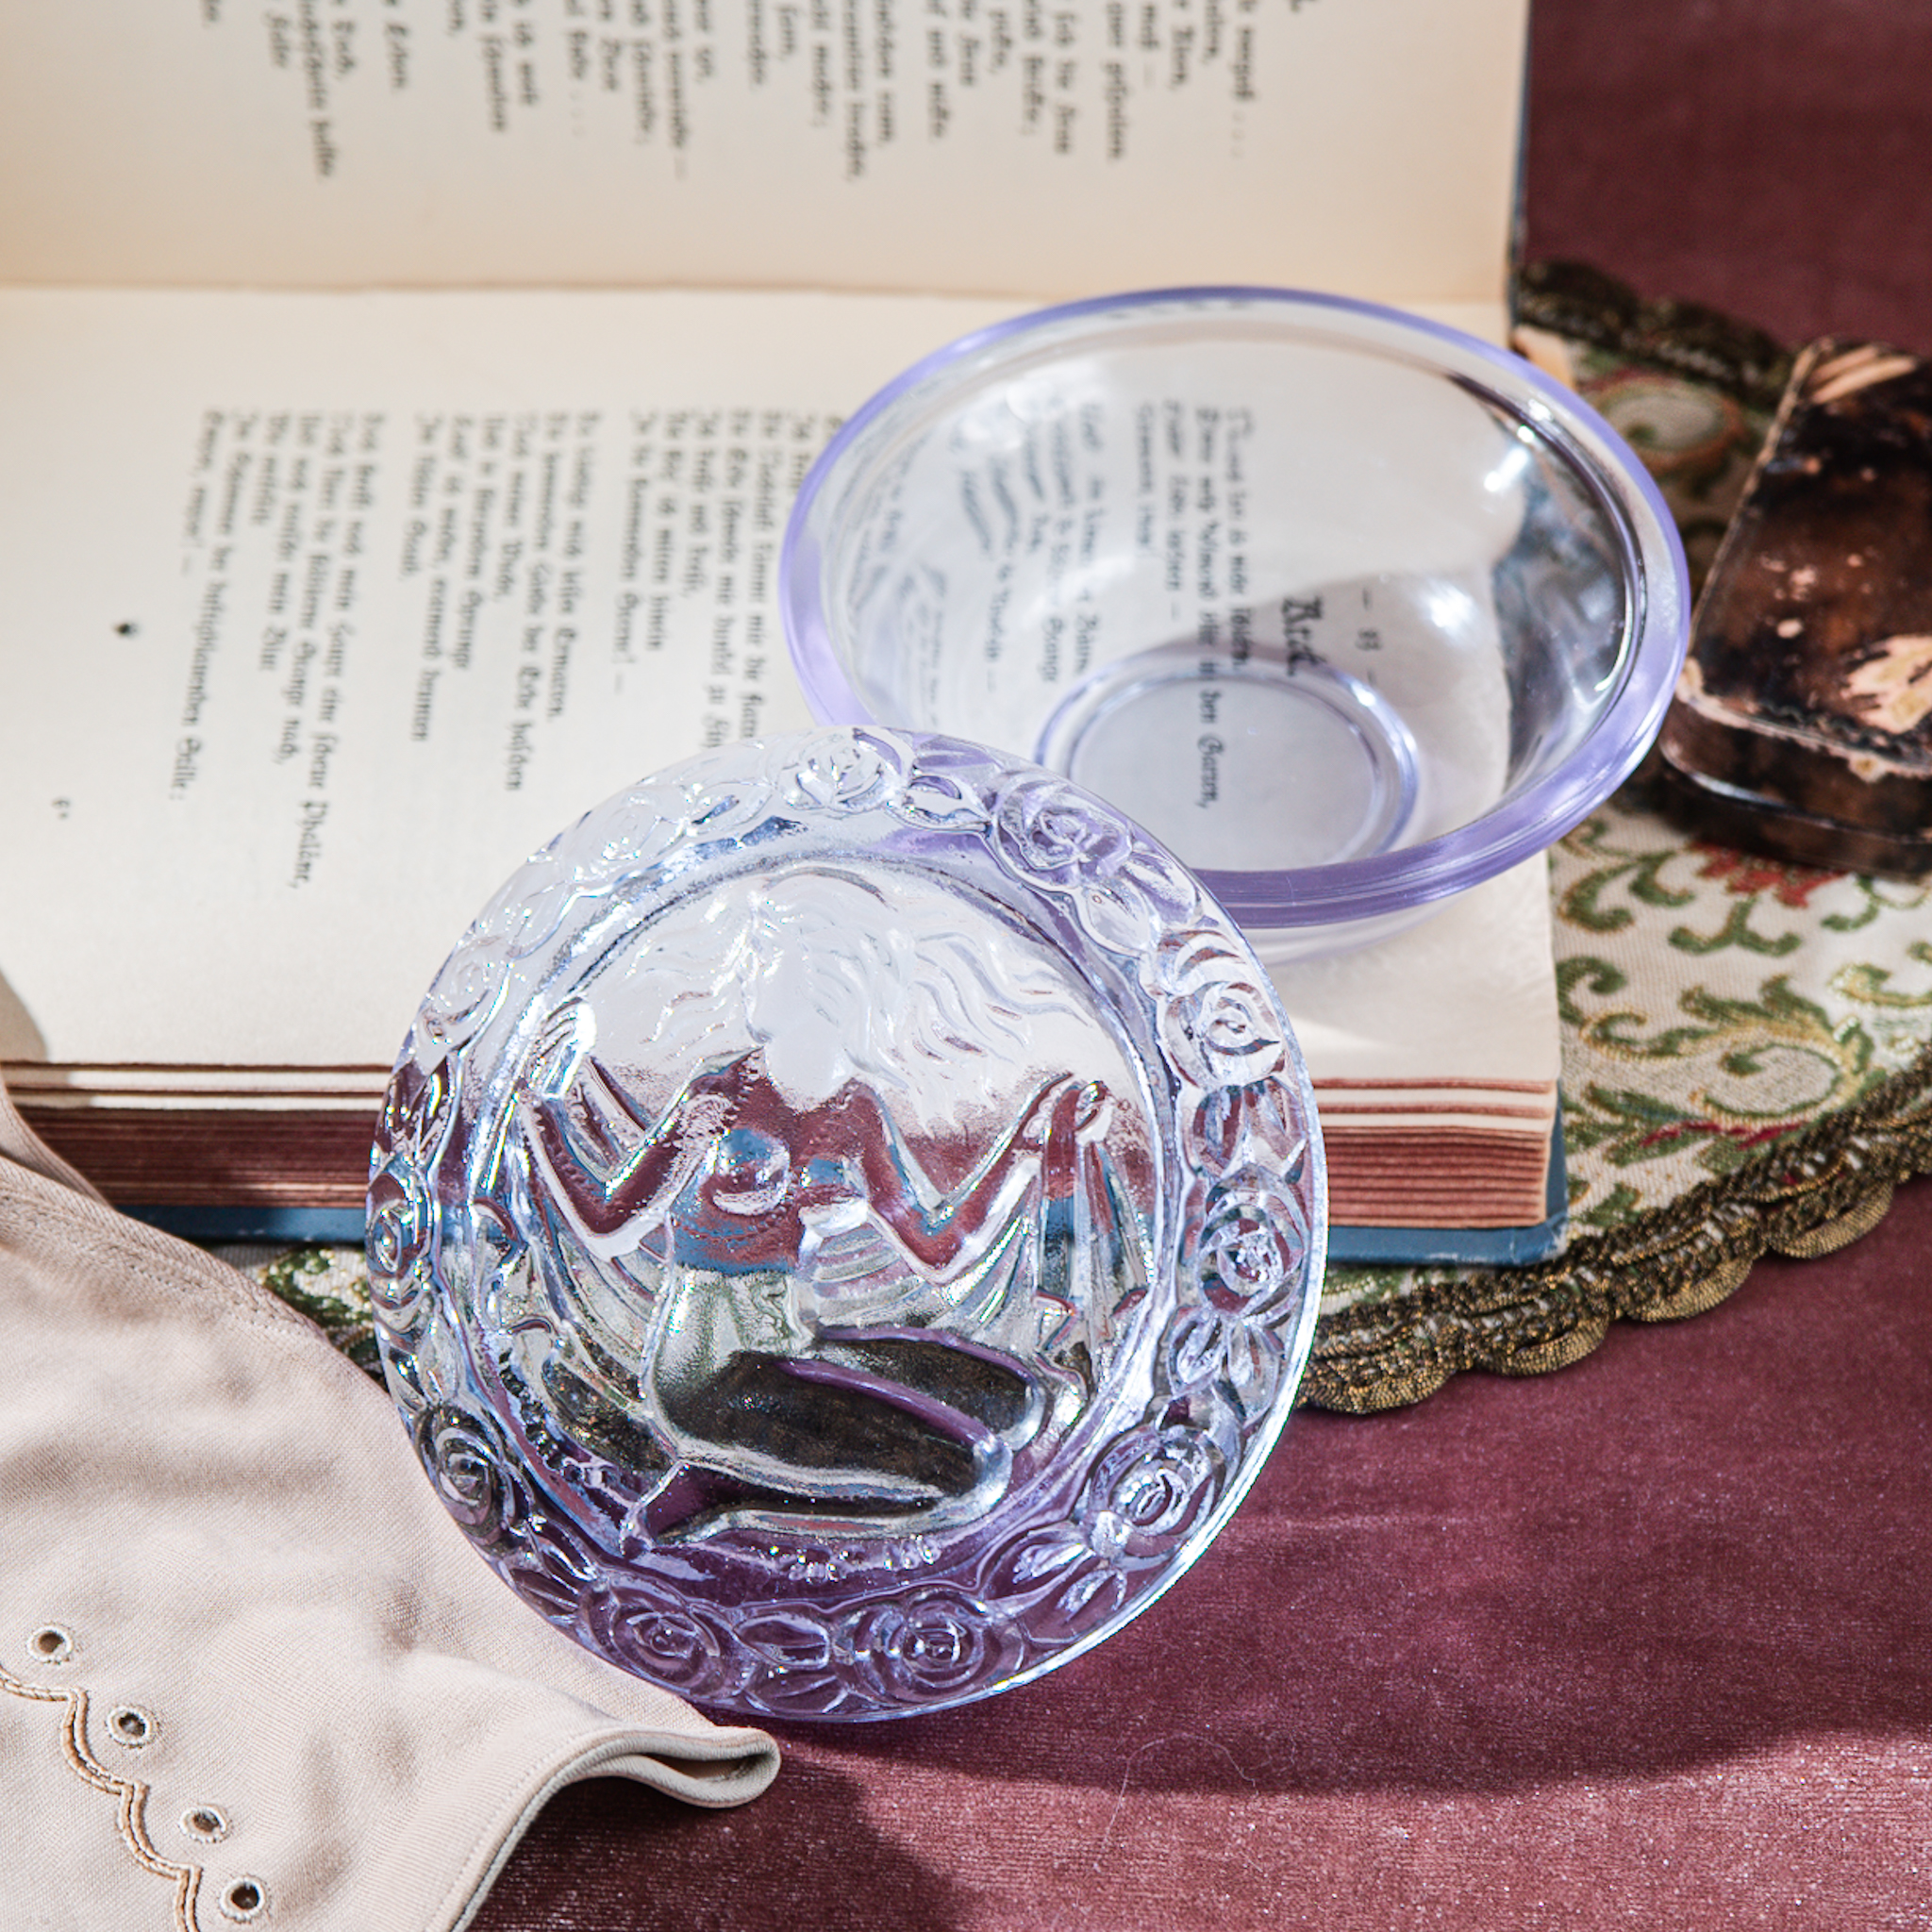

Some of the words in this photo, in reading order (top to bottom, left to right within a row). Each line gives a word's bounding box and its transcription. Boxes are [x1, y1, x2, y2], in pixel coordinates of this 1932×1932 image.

[413, 671, 440, 741] drunten
[1200, 690, 1222, 724] den
[275, 719, 300, 764] nach,
[508, 722, 532, 791] haschen
[1198, 735, 1224, 809] Garten,
[291, 801, 327, 891] Phaläne,
